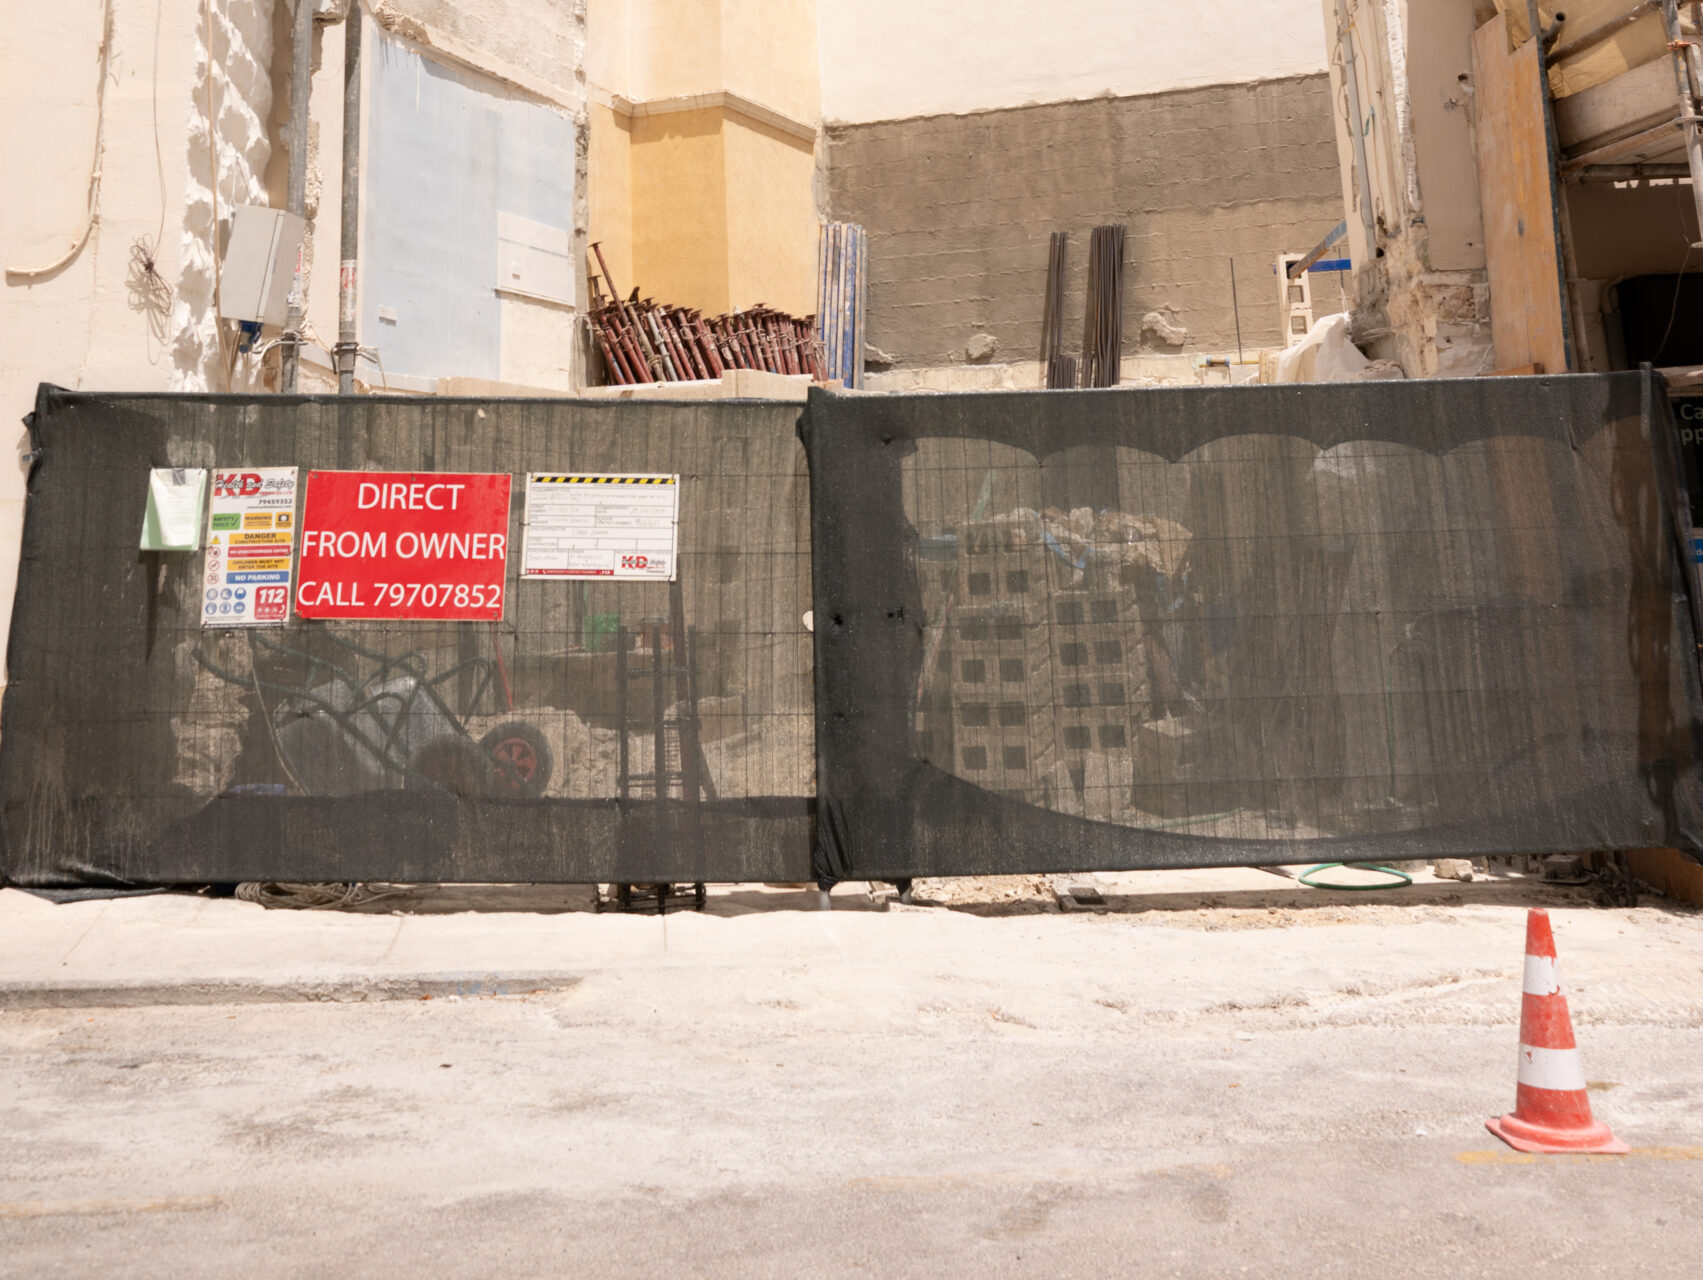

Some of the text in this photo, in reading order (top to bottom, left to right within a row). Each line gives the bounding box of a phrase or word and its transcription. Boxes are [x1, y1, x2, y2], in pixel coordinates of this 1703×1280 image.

[214, 473, 262, 496] KD
[246, 479, 263, 490] and
[264, 478, 294, 491] Safety
[358, 483, 465, 510] DIRECT
[302, 531, 505, 559] FROM OWNER
[260, 588, 285, 604] 112
[298, 581, 501, 608] CALL 79707852
